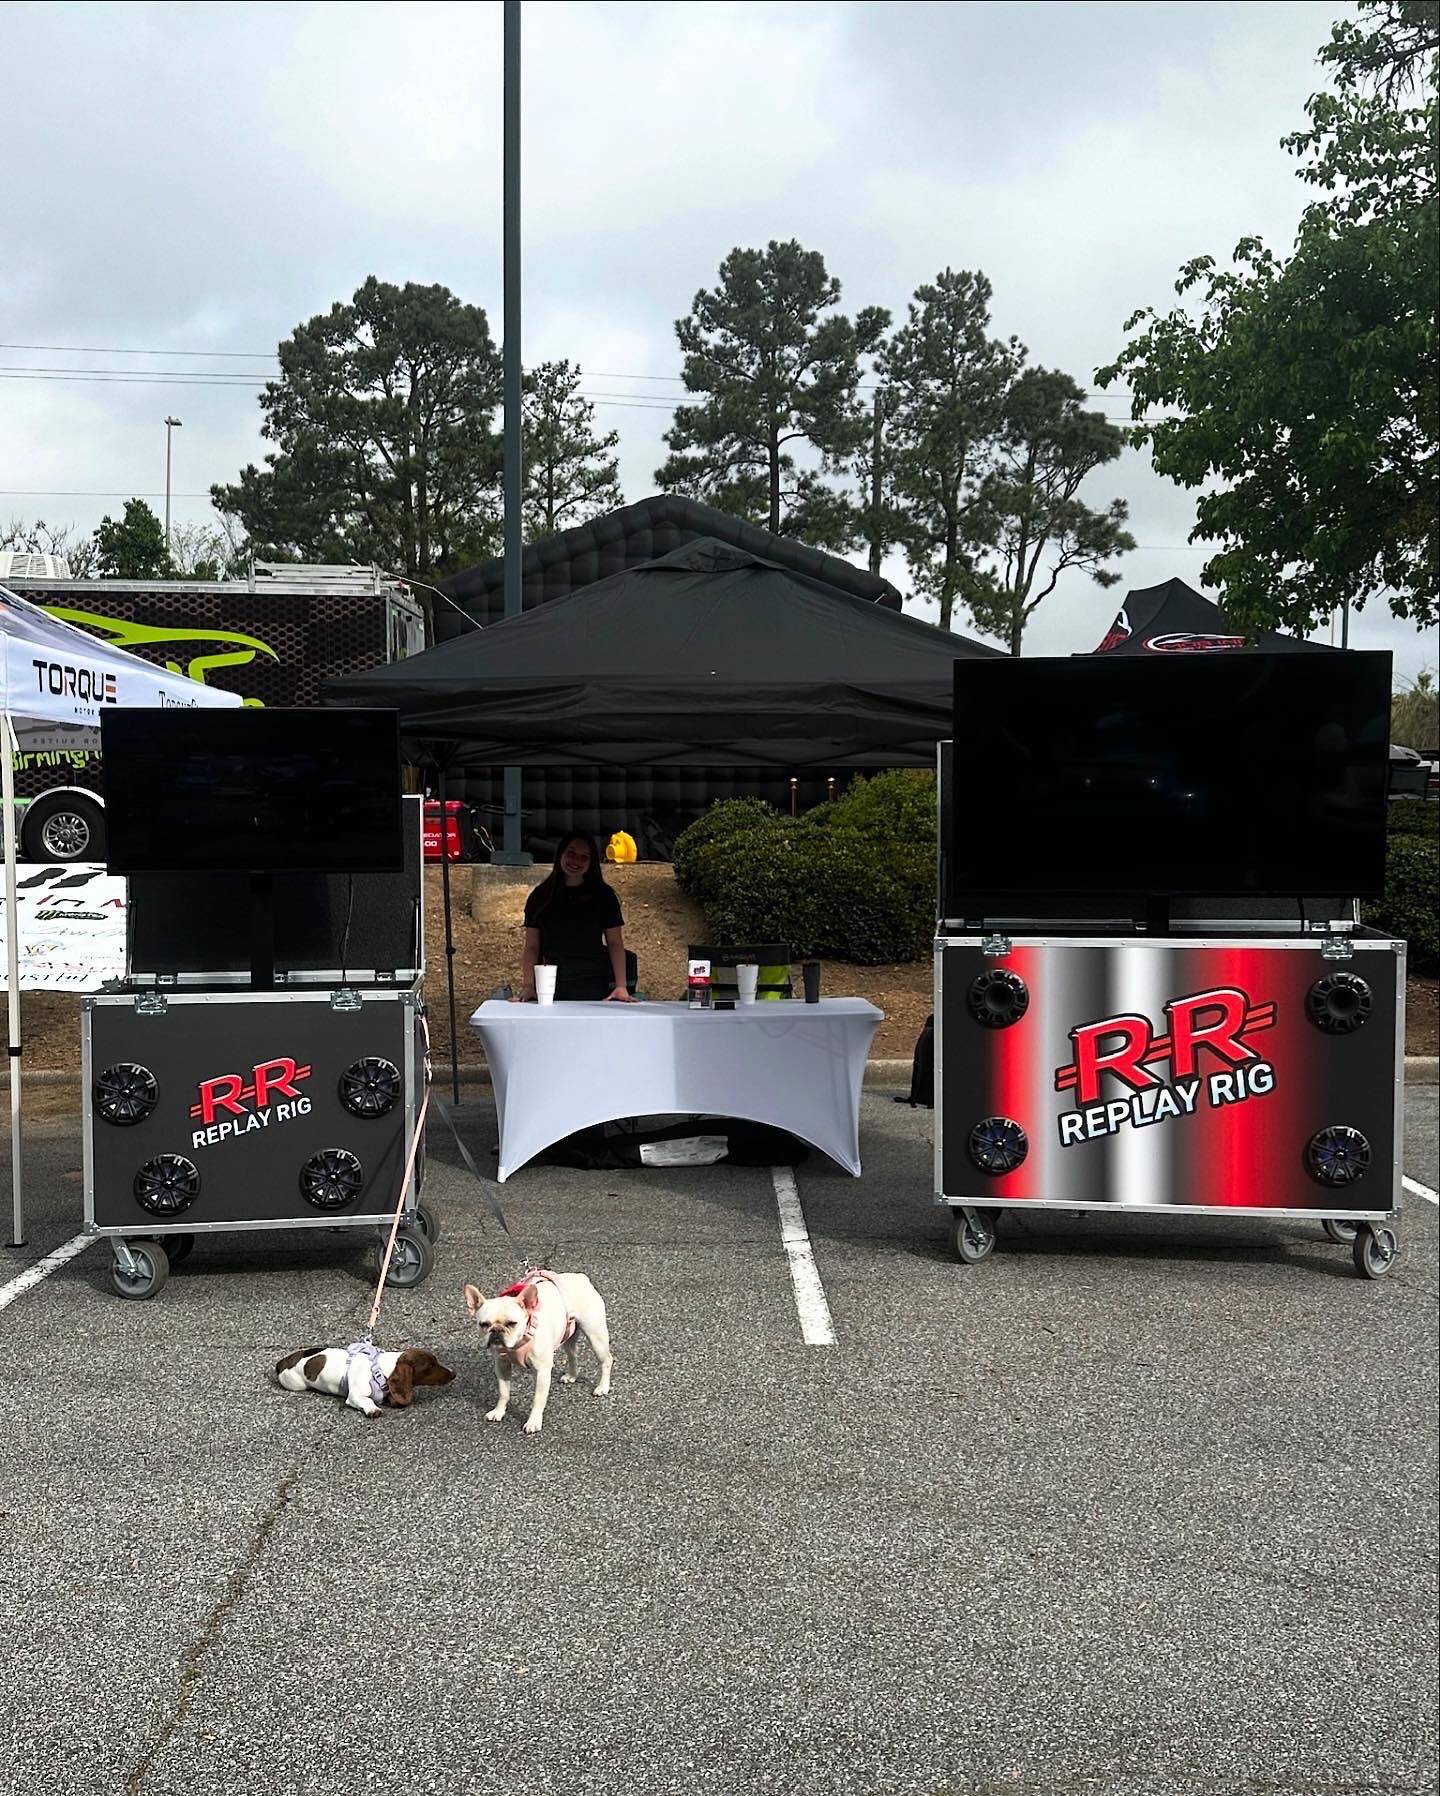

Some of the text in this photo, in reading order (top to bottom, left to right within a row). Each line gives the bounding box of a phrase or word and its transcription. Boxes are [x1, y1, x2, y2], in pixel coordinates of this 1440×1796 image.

[32, 659, 117, 704] TORQUE
[191, 1096, 312, 1150] REPLAY RIG
[1059, 1062, 1275, 1146] REPLAY RIG
